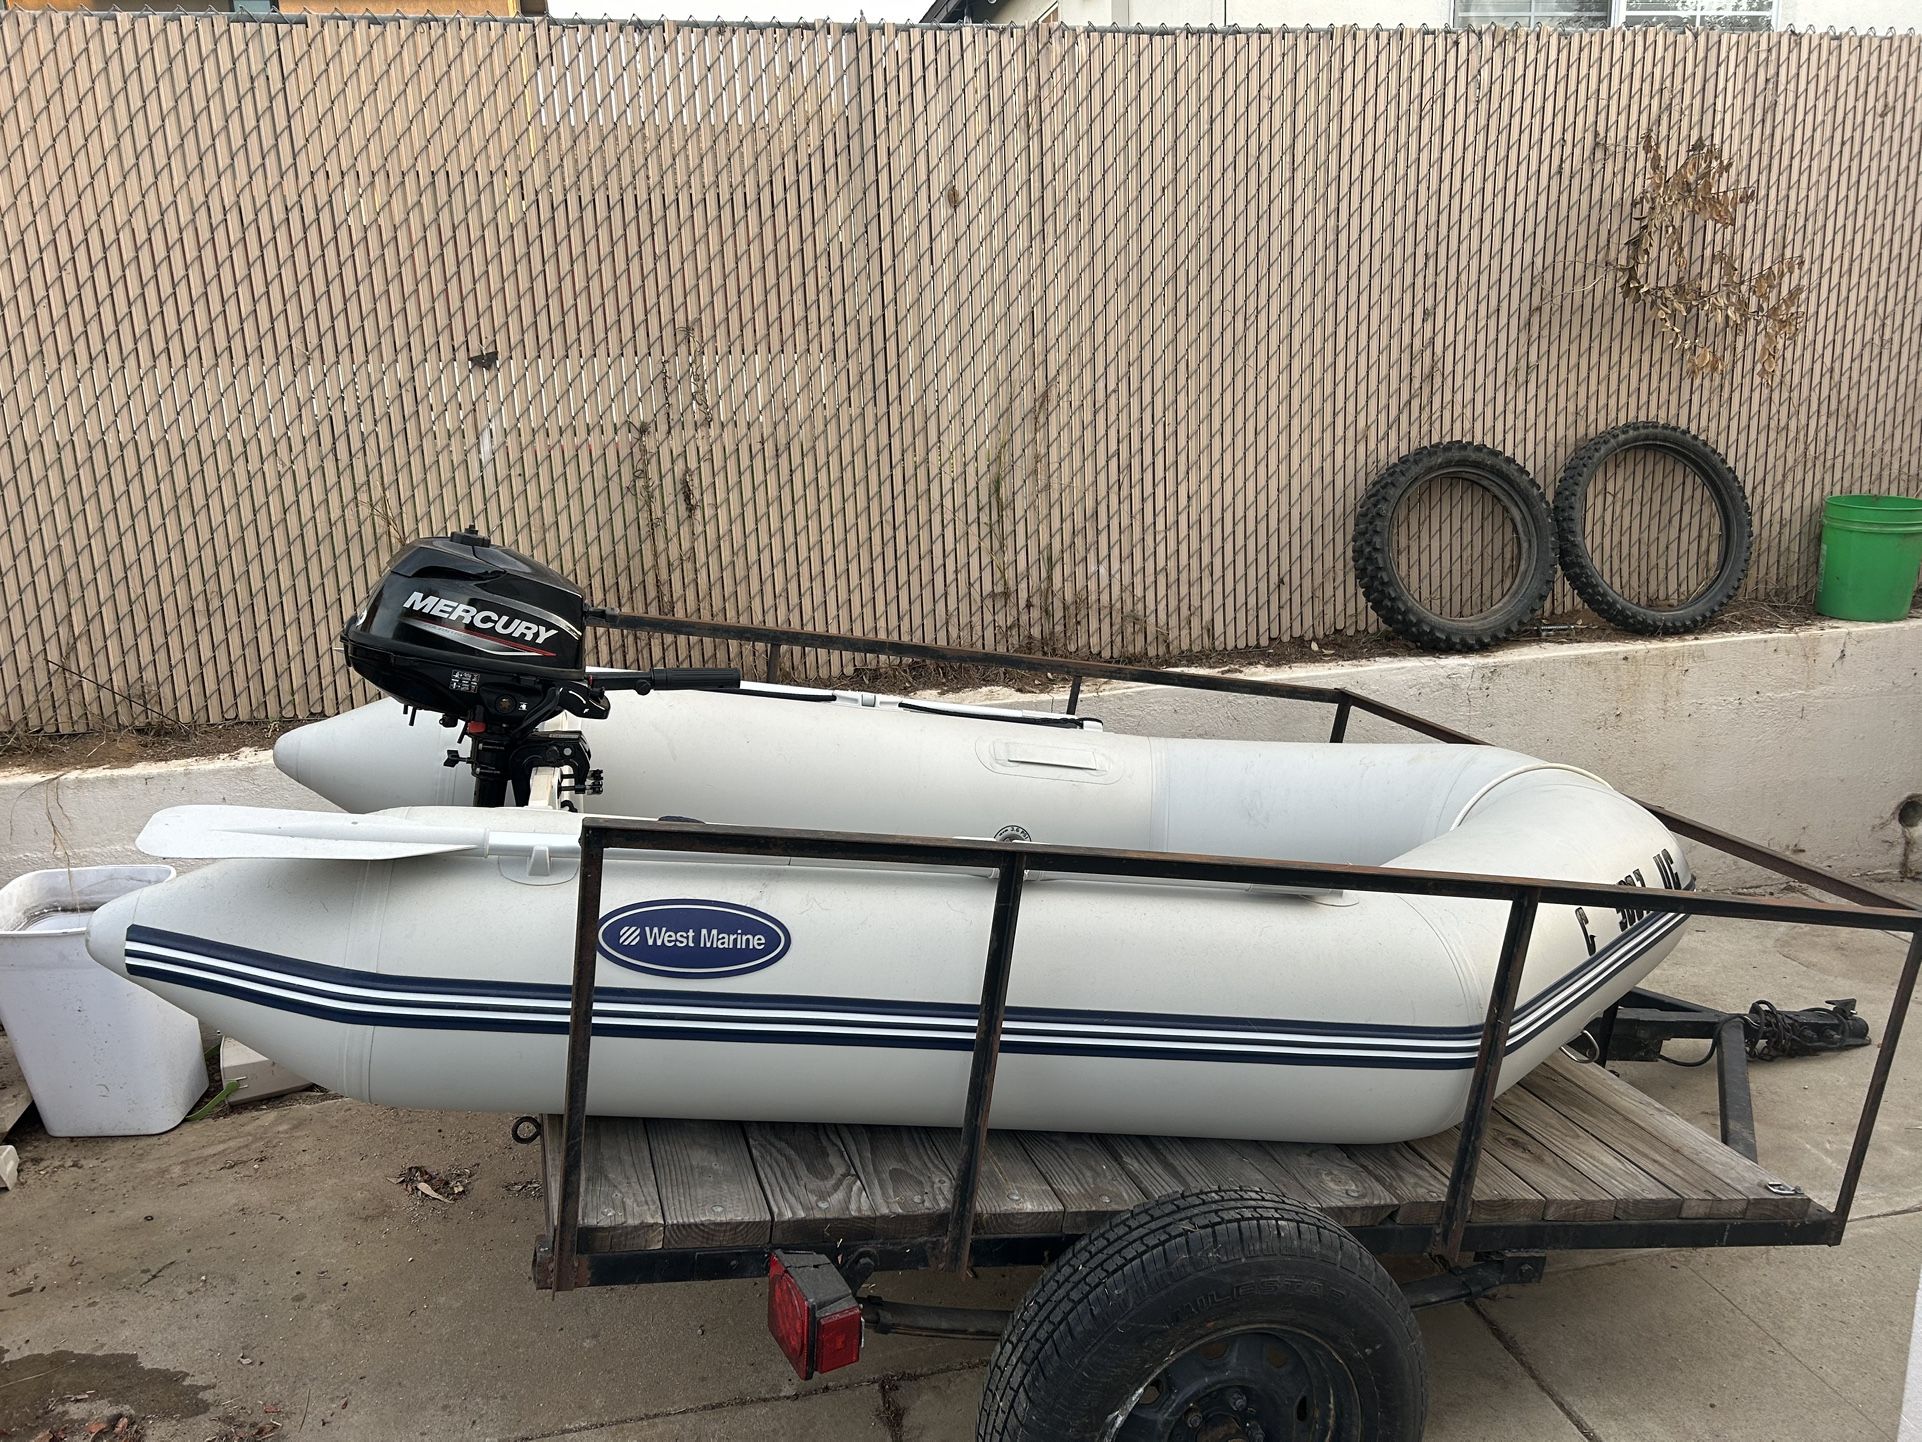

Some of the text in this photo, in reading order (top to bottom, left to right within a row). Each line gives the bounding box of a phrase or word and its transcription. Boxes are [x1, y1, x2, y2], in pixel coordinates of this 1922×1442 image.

[402, 590, 559, 645] MERCURY
[645, 926, 766, 950] West Marine
